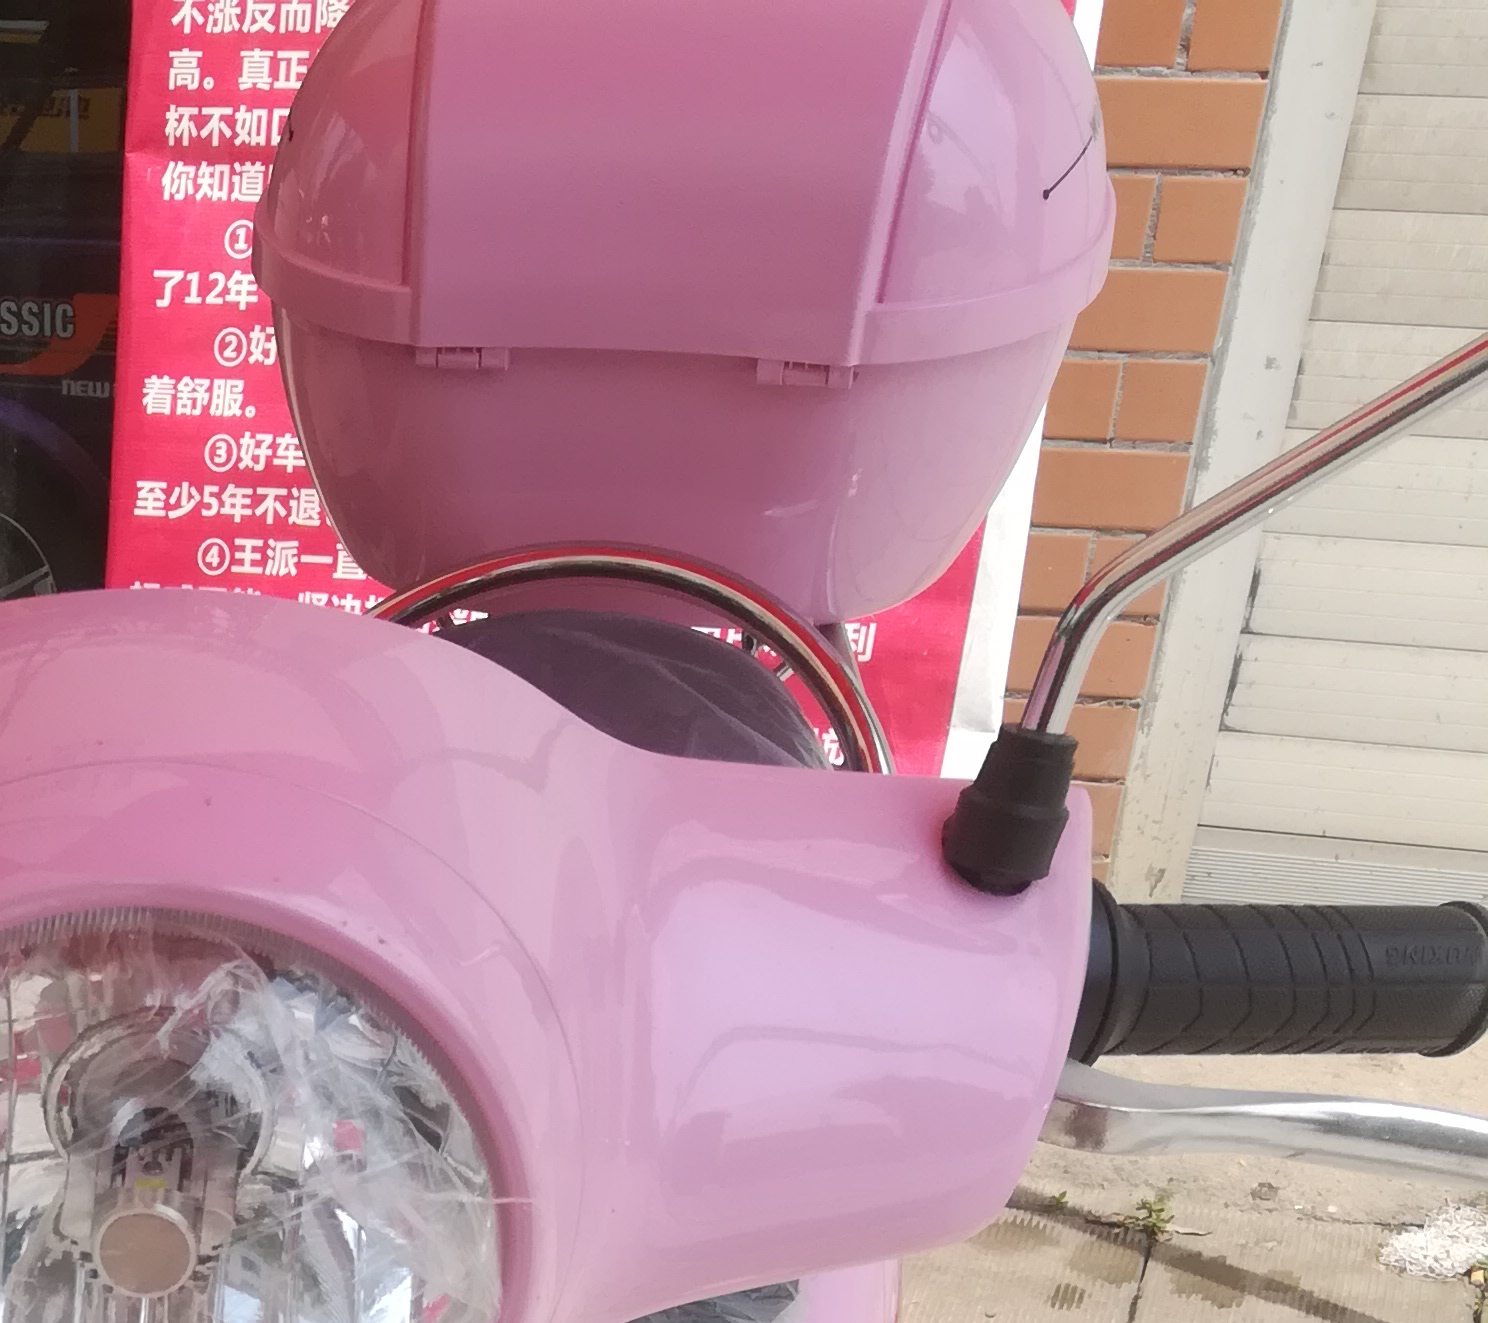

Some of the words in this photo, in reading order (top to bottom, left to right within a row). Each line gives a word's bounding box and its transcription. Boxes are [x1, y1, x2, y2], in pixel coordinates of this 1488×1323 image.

[161, 161, 273, 202] 你知道
[153, 269, 259, 310] 了12年
[142, 375, 256, 419] 着舒服。
